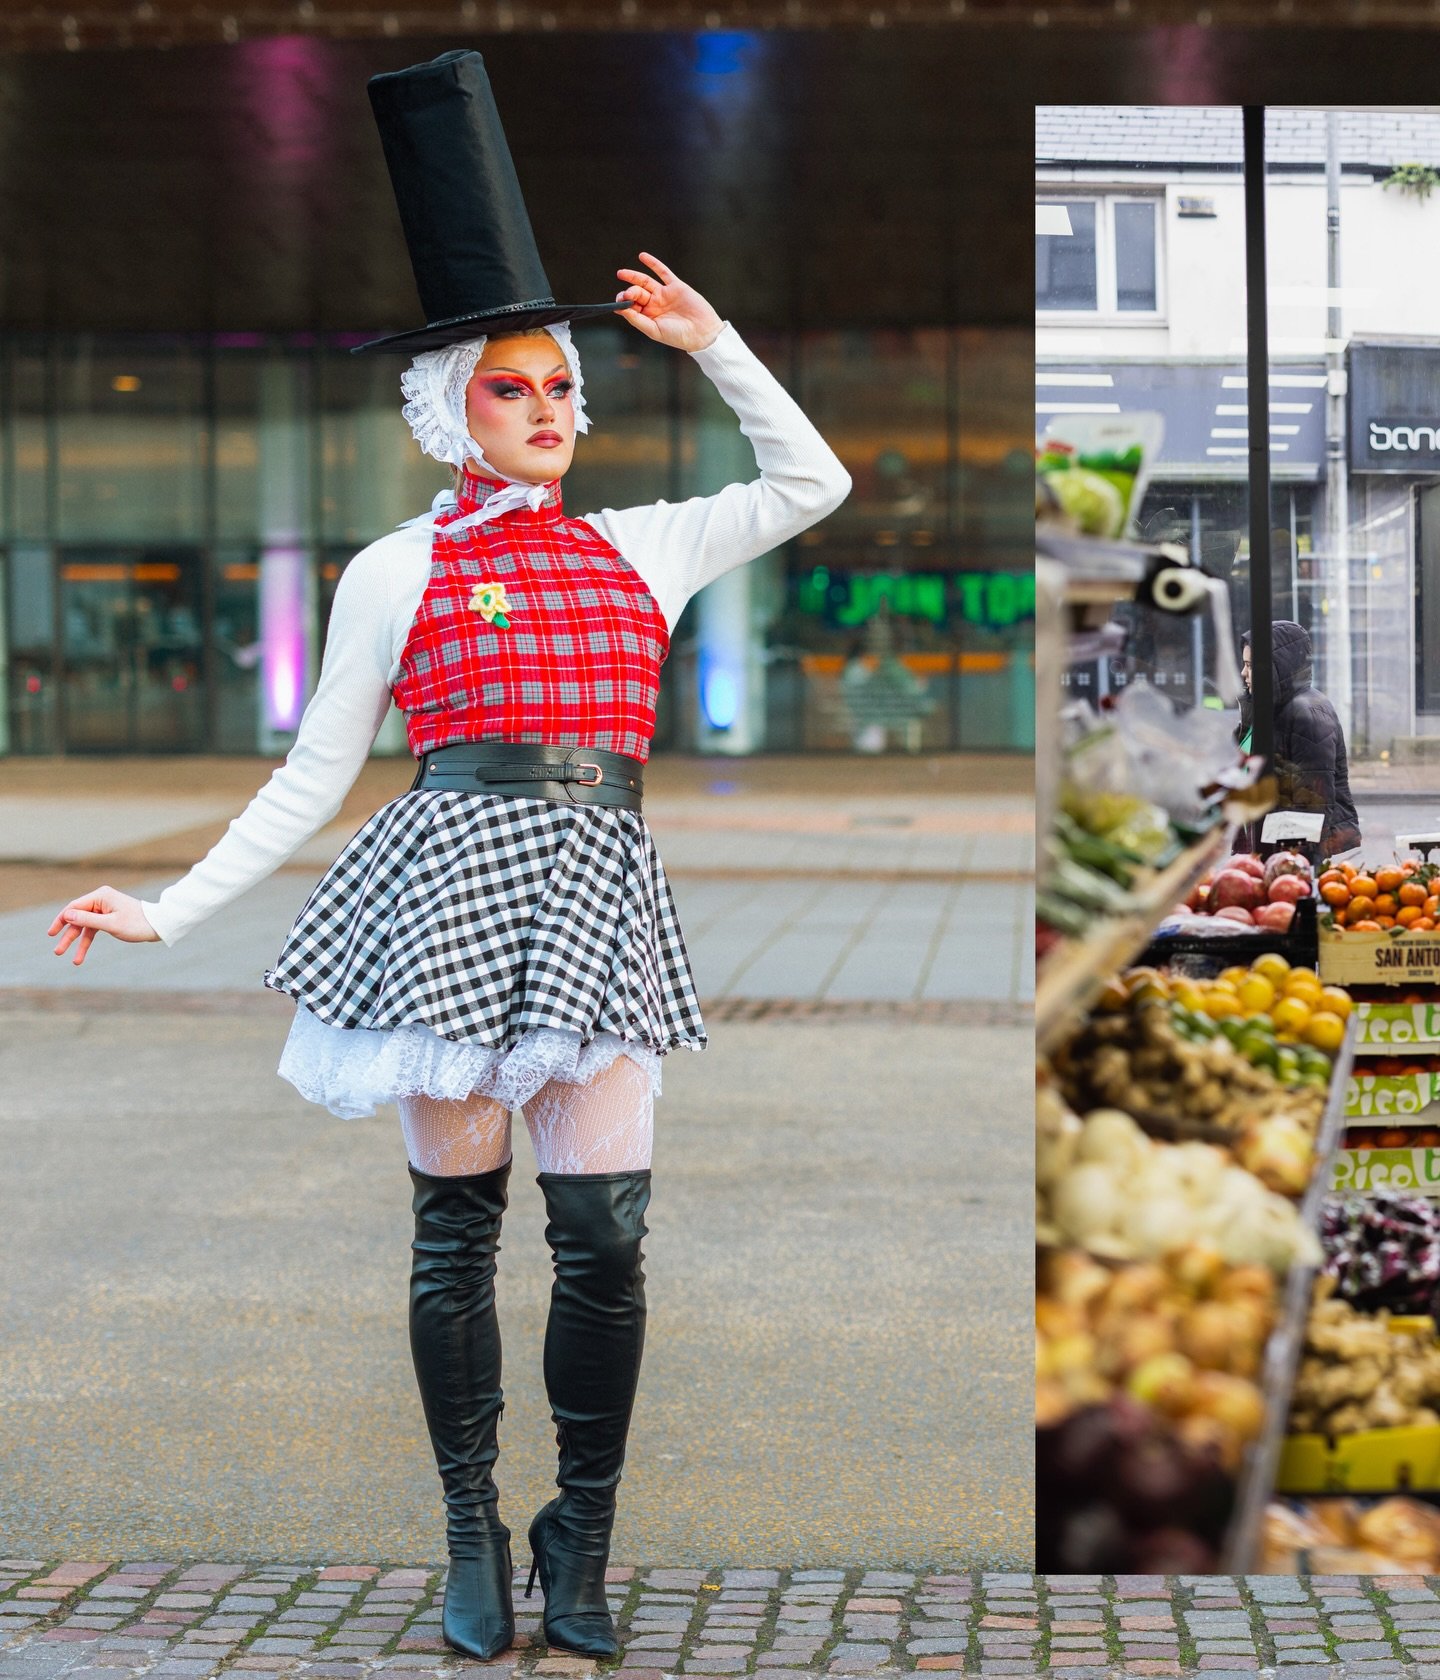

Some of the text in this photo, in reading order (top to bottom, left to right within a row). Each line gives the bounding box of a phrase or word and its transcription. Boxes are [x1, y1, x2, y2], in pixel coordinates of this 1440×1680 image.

[1369, 422, 1440, 451] ban
[1375, 947, 1403, 967] SAN
[1355, 1003, 1413, 1043] ico
